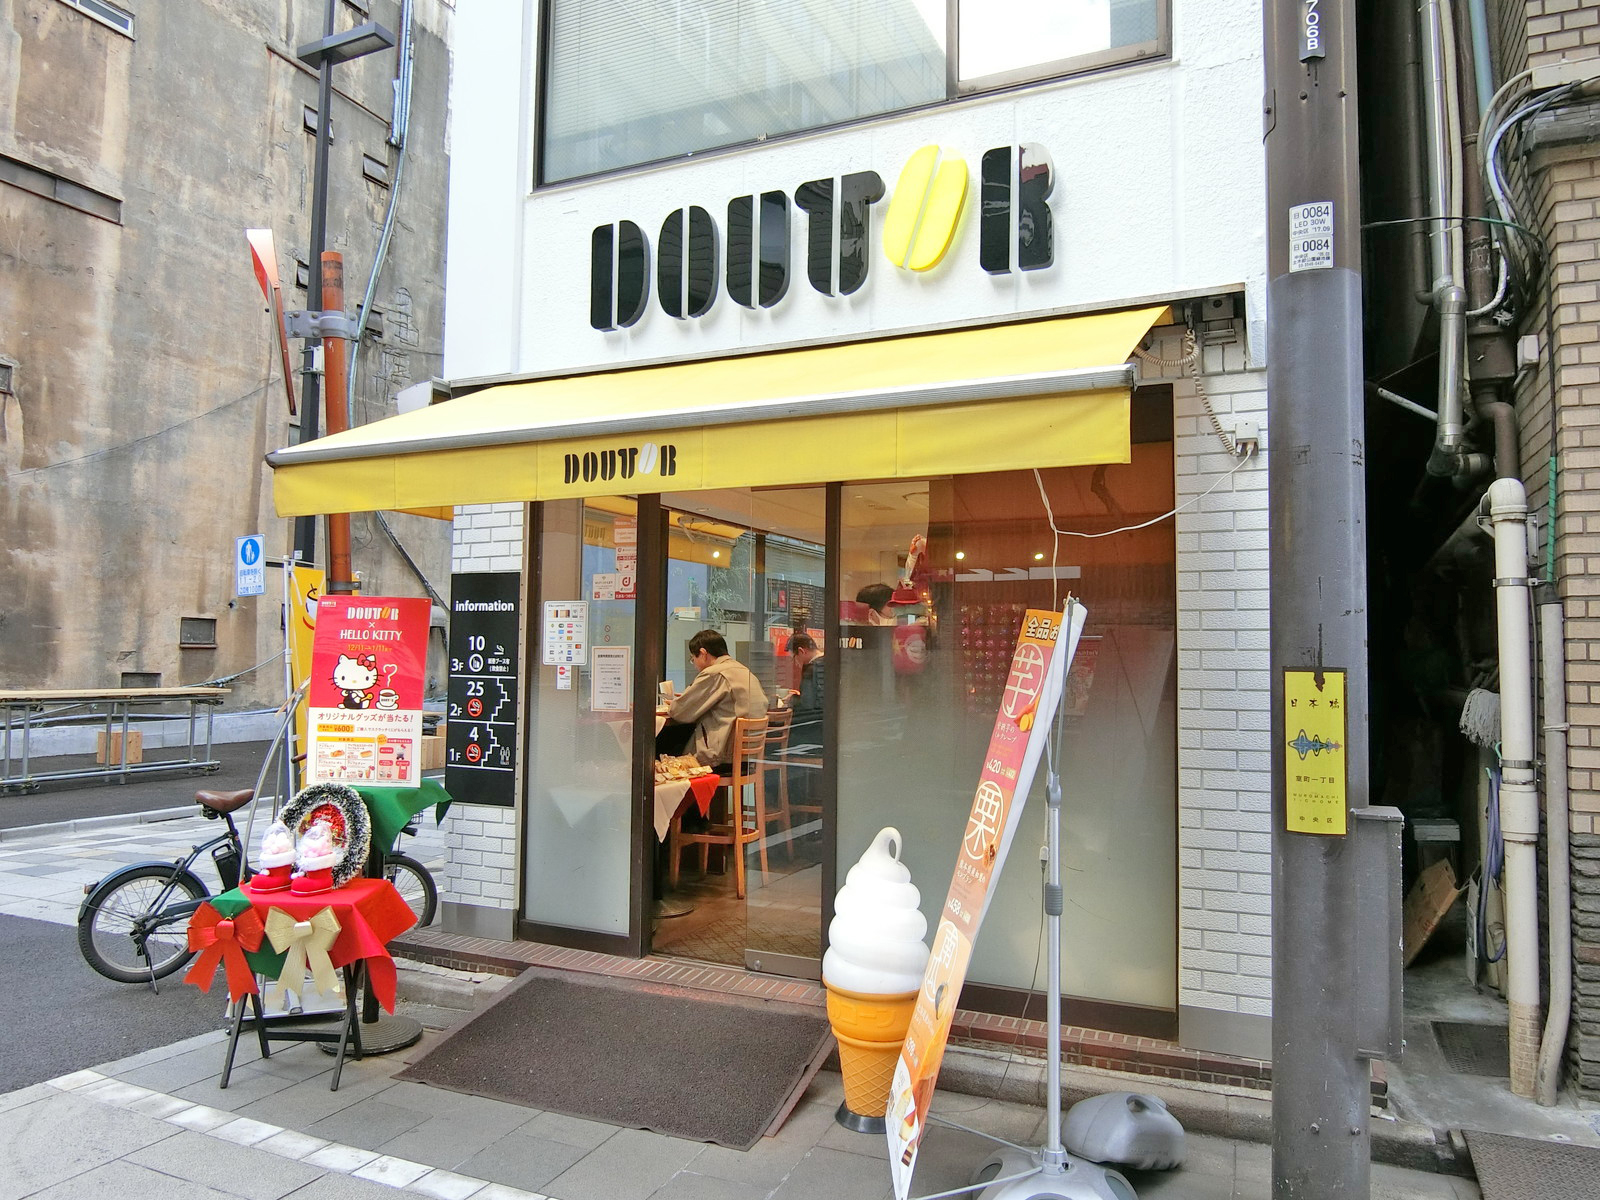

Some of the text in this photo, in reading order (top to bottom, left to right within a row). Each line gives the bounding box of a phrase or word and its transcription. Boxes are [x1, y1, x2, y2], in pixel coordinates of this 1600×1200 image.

[1305, 0, 1319, 50] 706B
[1302, 205, 1329, 219] 0084
[1294, 218, 1326, 228] LED 30W
[590, 142, 1055, 332] DOUTOR
[1302, 239, 1329, 252] 0084
[564, 443, 677, 484] DOUTOR
[455, 600, 514, 612] information
[347, 607, 399, 620] DOUTOR
[340, 629, 402, 641] HELLO KITTY
[469, 635, 485, 651] 10
[451, 658, 464, 671] 3F
[1005, 648, 1043, 714] 芋
[467, 681, 484, 696] 25
[450, 703, 462, 716] 2F
[1291, 698, 1340, 709] 日本橋
[469, 726, 479, 742] 4
[449, 748, 461, 761] 1F
[1296, 775, 1335, 784] 室町一丁目
[966, 785, 1000, 852] 栗
[1299, 815, 1333, 823] 中央区
